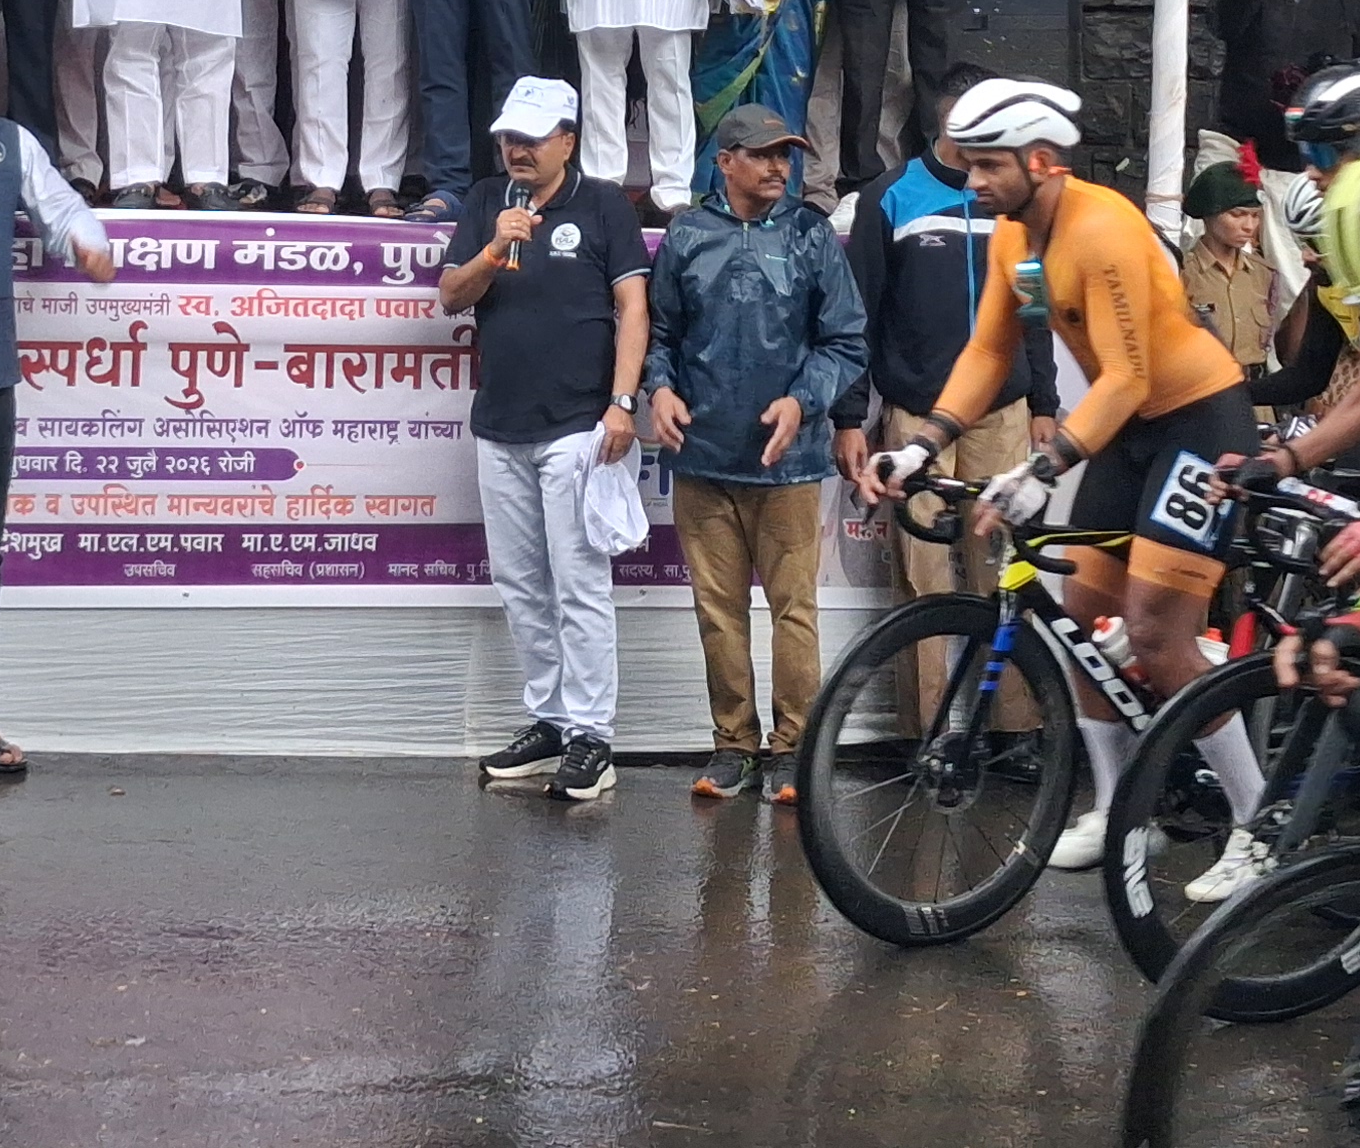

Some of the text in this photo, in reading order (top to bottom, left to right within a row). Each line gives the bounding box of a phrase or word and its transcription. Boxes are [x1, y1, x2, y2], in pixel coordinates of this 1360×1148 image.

[232, 227, 364, 275] मंडळ,
[41, 291, 78, 314] माजी
[86, 292, 171, 322] उपमुख्यमंत्री
[177, 295, 219, 317] स्व.
[230, 288, 366, 320] अजितदादा
[374, 298, 437, 319] पवार
[16, 320, 148, 391] स्पर्धा
[37, 409, 145, 439] सायकलिंग
[153, 409, 271, 443] असोसिएशन
[279, 410, 324, 440] ऑफ
[332, 420, 400, 445] महाराष्ट्र
[408, 411, 464, 440] यांच्या
[11, 455, 59, 478] ुधवार
[96, 455, 119, 474] २२
[127, 449, 159, 478] जुलै
[165, 455, 212, 475] २०२६
[218, 451, 256, 475] रोजी
[45, 494, 62, 516] व
[70, 483, 158, 517] उपस्थित
[167, 484, 277, 518] मान्यवरांचे
[285, 484, 357, 520] हार्दिक
[364, 495, 438, 518] स्वागत
[123, 559, 177, 578] उपसचिव
[251, 559, 304, 579] सहसचिव
[387, 563, 419, 578] मानद
[1050, 617, 1152, 731] LOO
